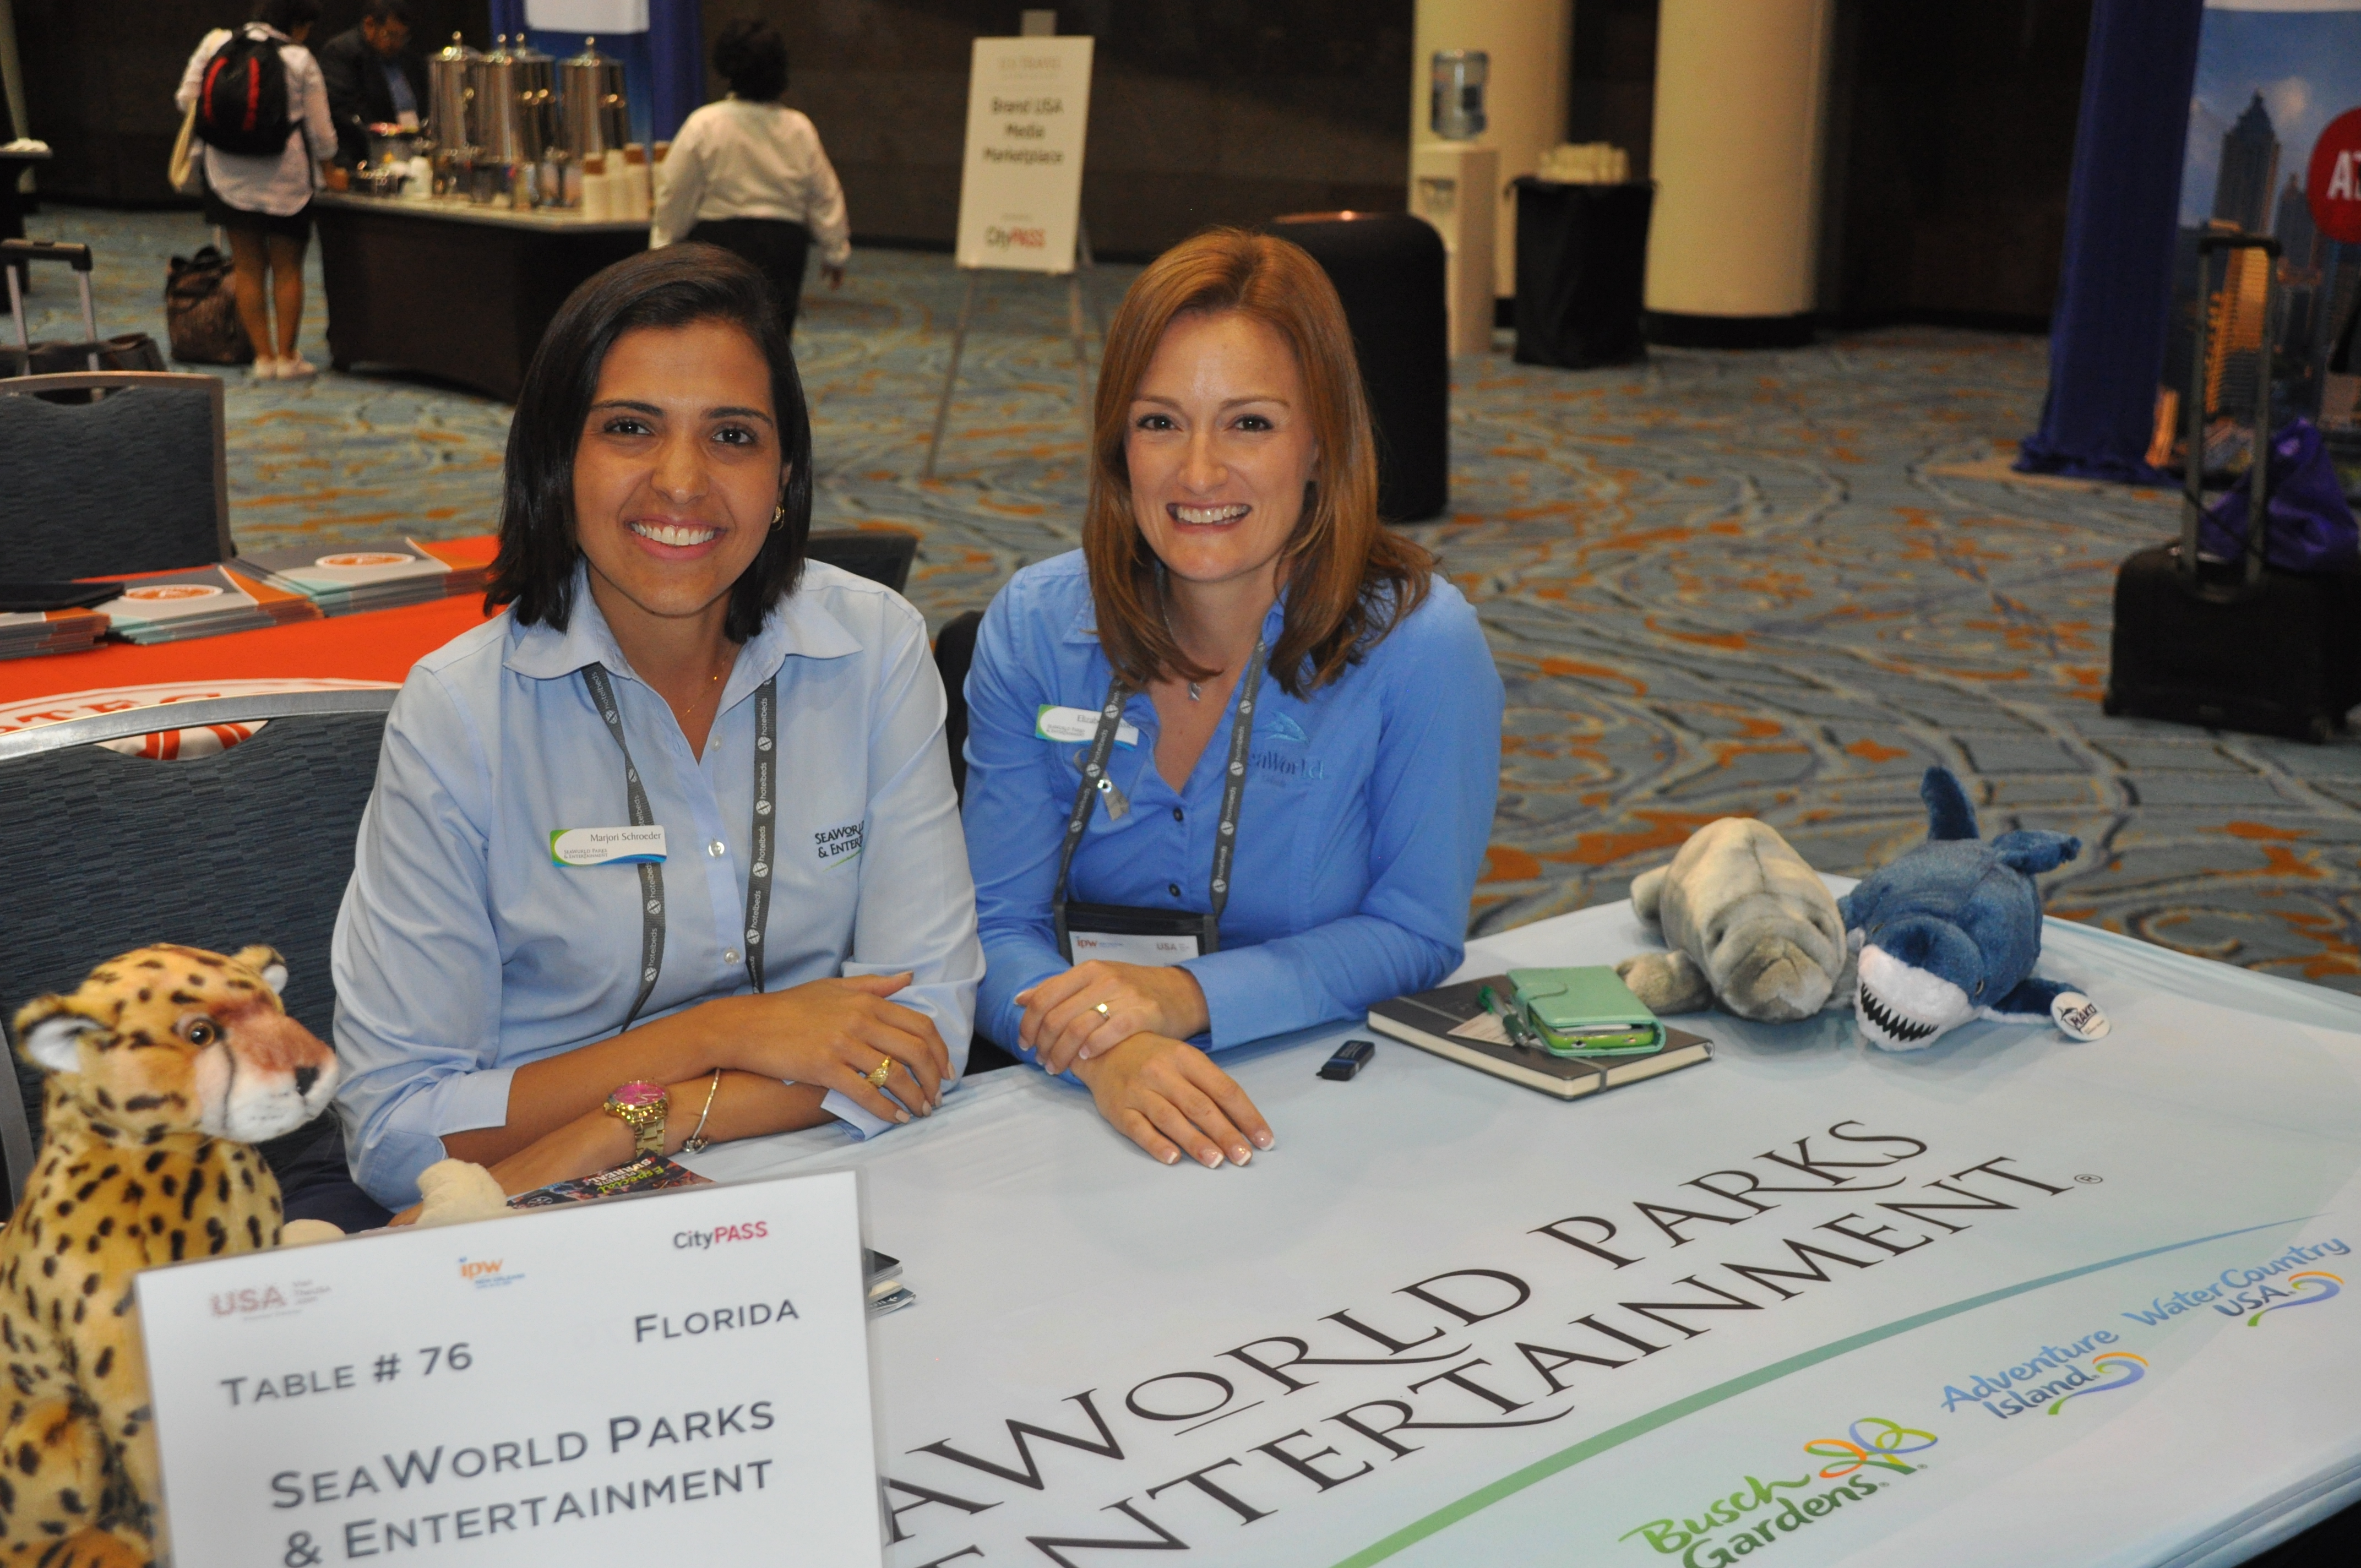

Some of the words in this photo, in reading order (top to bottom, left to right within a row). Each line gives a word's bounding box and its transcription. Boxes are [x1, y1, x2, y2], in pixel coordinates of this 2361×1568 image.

[634, 795, 645, 826] otelbeds
[590, 834, 619, 843] Marjori
[622, 831, 661, 840] Schroeder
[758, 825, 766, 862] hotelbeds
[818, 846, 829, 858] &
[751, 890, 761, 929] hotelbeds
[649, 928, 657, 966] hotelbeds
[673, 1221, 769, 1249] CityPASS
[211, 1284, 287, 1317] USA
[2121, 1283, 2224, 1326] Water
[2218, 1238, 2352, 1289] Country
[2213, 1284, 2289, 1318] USA
[634, 1299, 799, 1343] FLORIDA
[877, 1268, 1531, 1547] AWORLD
[1526, 1120, 1928, 1270] PARKS
[220, 1365, 356, 1407] TABLE
[373, 1353, 401, 1383] #
[419, 1342, 474, 1376] 76
[1940, 1329, 2119, 1413] Adventure
[271, 1431, 589, 1509] SEAWORLD
[609, 1400, 775, 1453] PARKS
[284, 1530, 322, 1568] &
[344, 1459, 773, 1559] ENTERTAINMENT
[1618, 1474, 1811, 1554] Busch
[1682, 1474, 1879, 1568] Gardens
